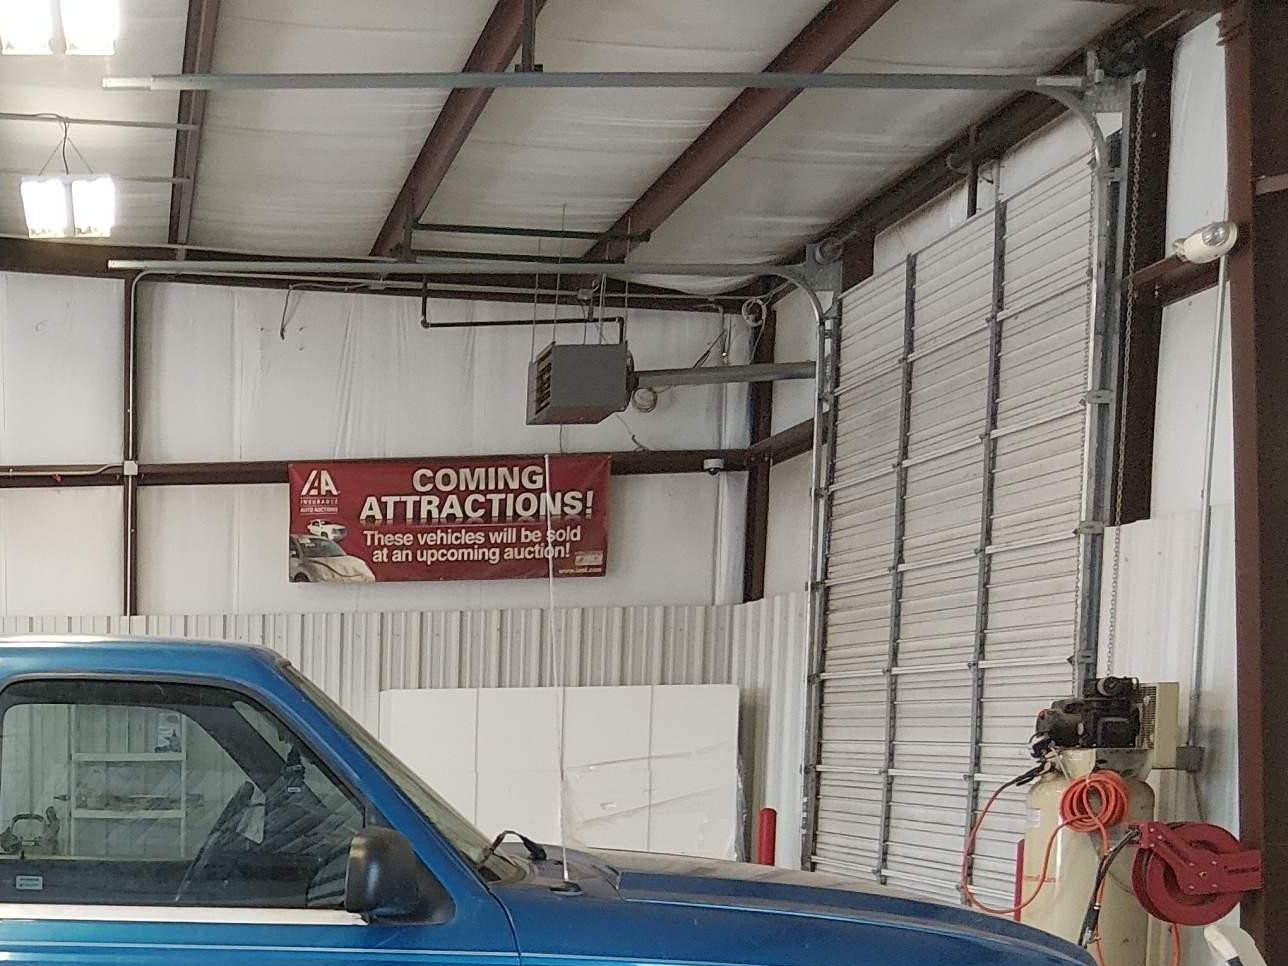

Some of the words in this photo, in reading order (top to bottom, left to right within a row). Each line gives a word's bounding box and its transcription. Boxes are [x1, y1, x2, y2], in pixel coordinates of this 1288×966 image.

[412, 465, 544, 492] COMING
[359, 490, 594, 520] ATTRACTIONS!
[363, 530, 414, 546] These
[417, 528, 485, 545] vehicles
[489, 527, 517, 544] will
[520, 527, 542, 543] be
[546, 525, 581, 542] sold
[372, 548, 389, 563] at
[392, 549, 413, 563] an
[416, 545, 500, 566] upcoming
[503, 543, 570, 561] auction!
